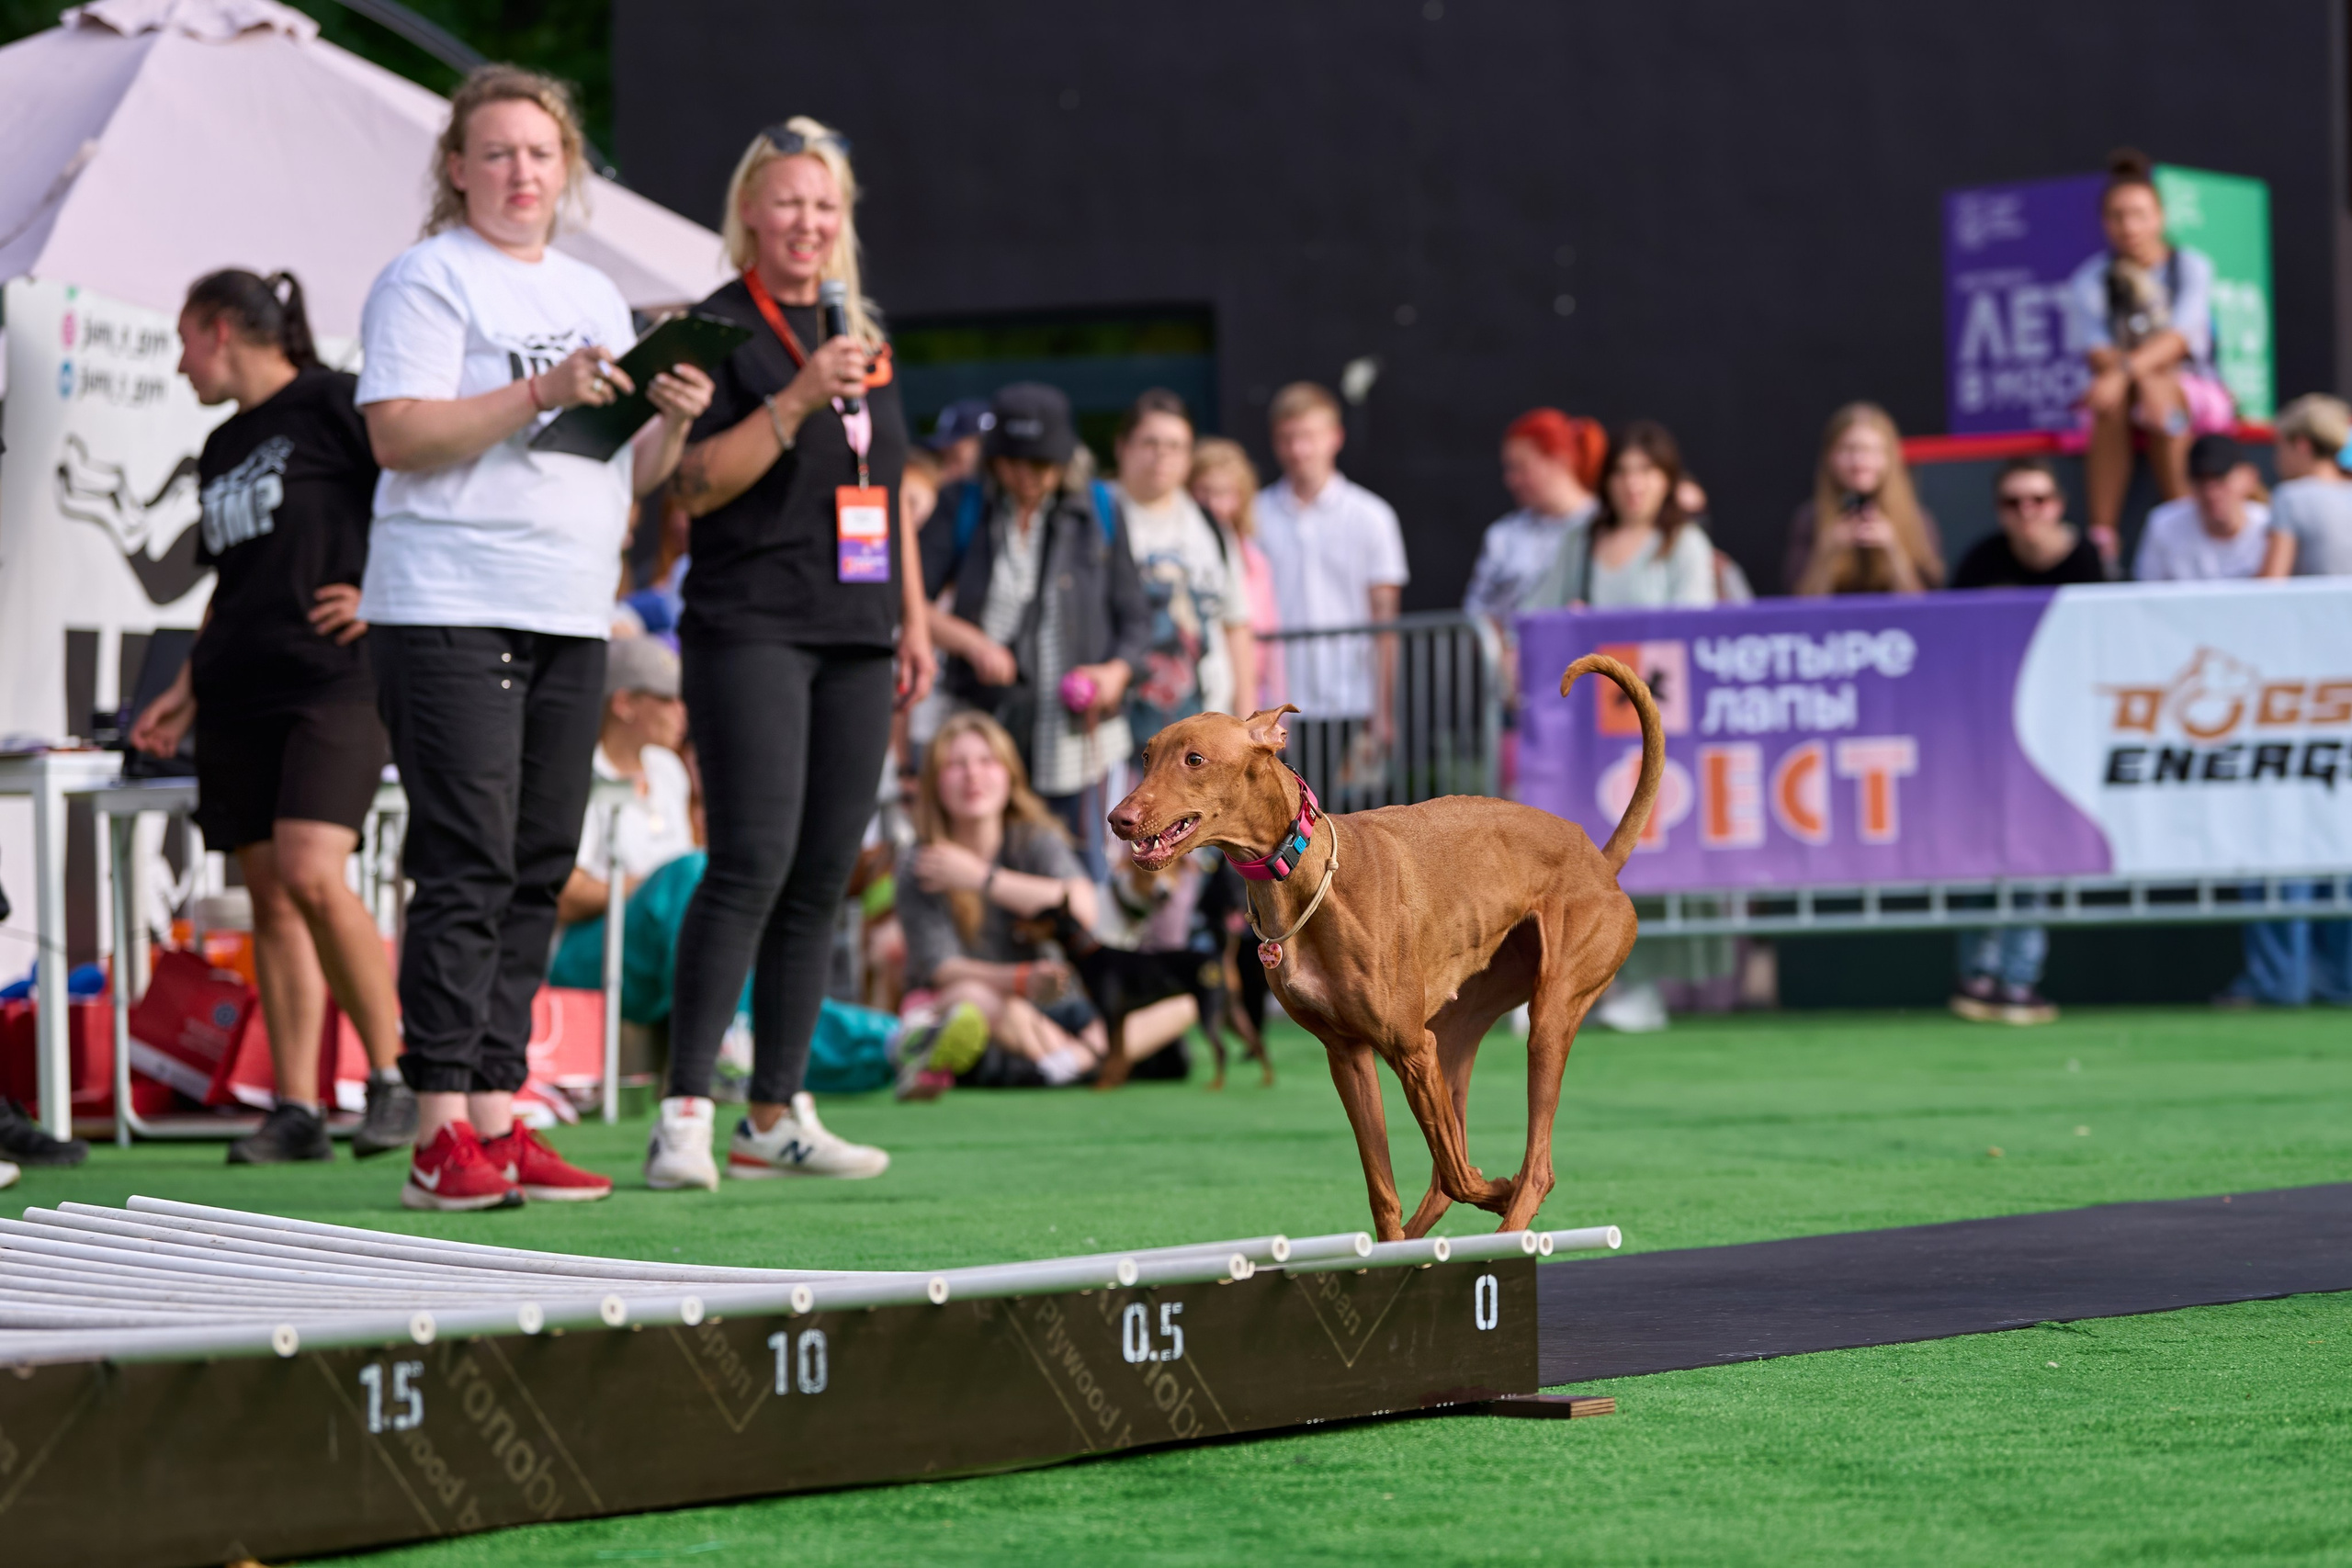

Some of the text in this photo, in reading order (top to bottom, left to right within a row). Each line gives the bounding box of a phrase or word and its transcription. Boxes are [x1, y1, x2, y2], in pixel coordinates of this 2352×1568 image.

[1958, 282, 2089, 362] ЛЕТ
[1693, 628, 1917, 682] четыре
[1701, 682, 1858, 734] лапы
[2104, 739, 2352, 792] ENERG
[1475, 1274, 1498, 1330] 0
[1122, 1302, 1184, 1363] 0.5
